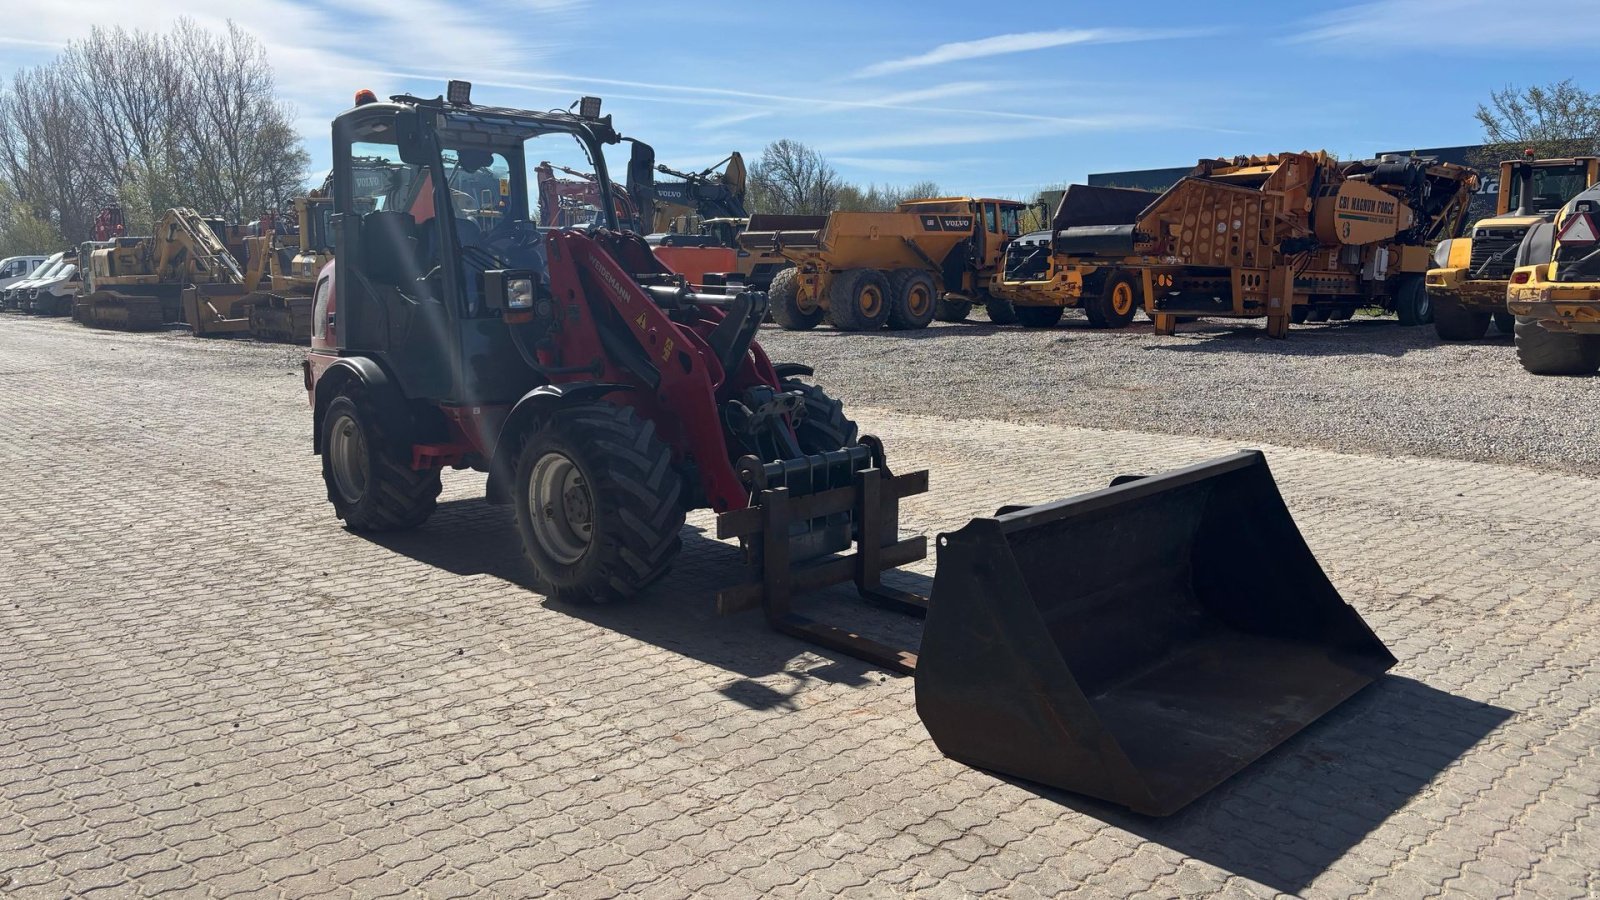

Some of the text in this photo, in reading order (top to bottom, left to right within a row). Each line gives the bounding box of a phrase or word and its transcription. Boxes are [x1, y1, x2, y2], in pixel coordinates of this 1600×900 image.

[356, 176, 379, 188] VOLVO
[657, 190, 682, 198] VOLVO
[1351, 197, 1376, 212] MAGNUM
[1376, 201, 1395, 215] FORCE
[588, 251, 631, 304] WEIDEMANN
